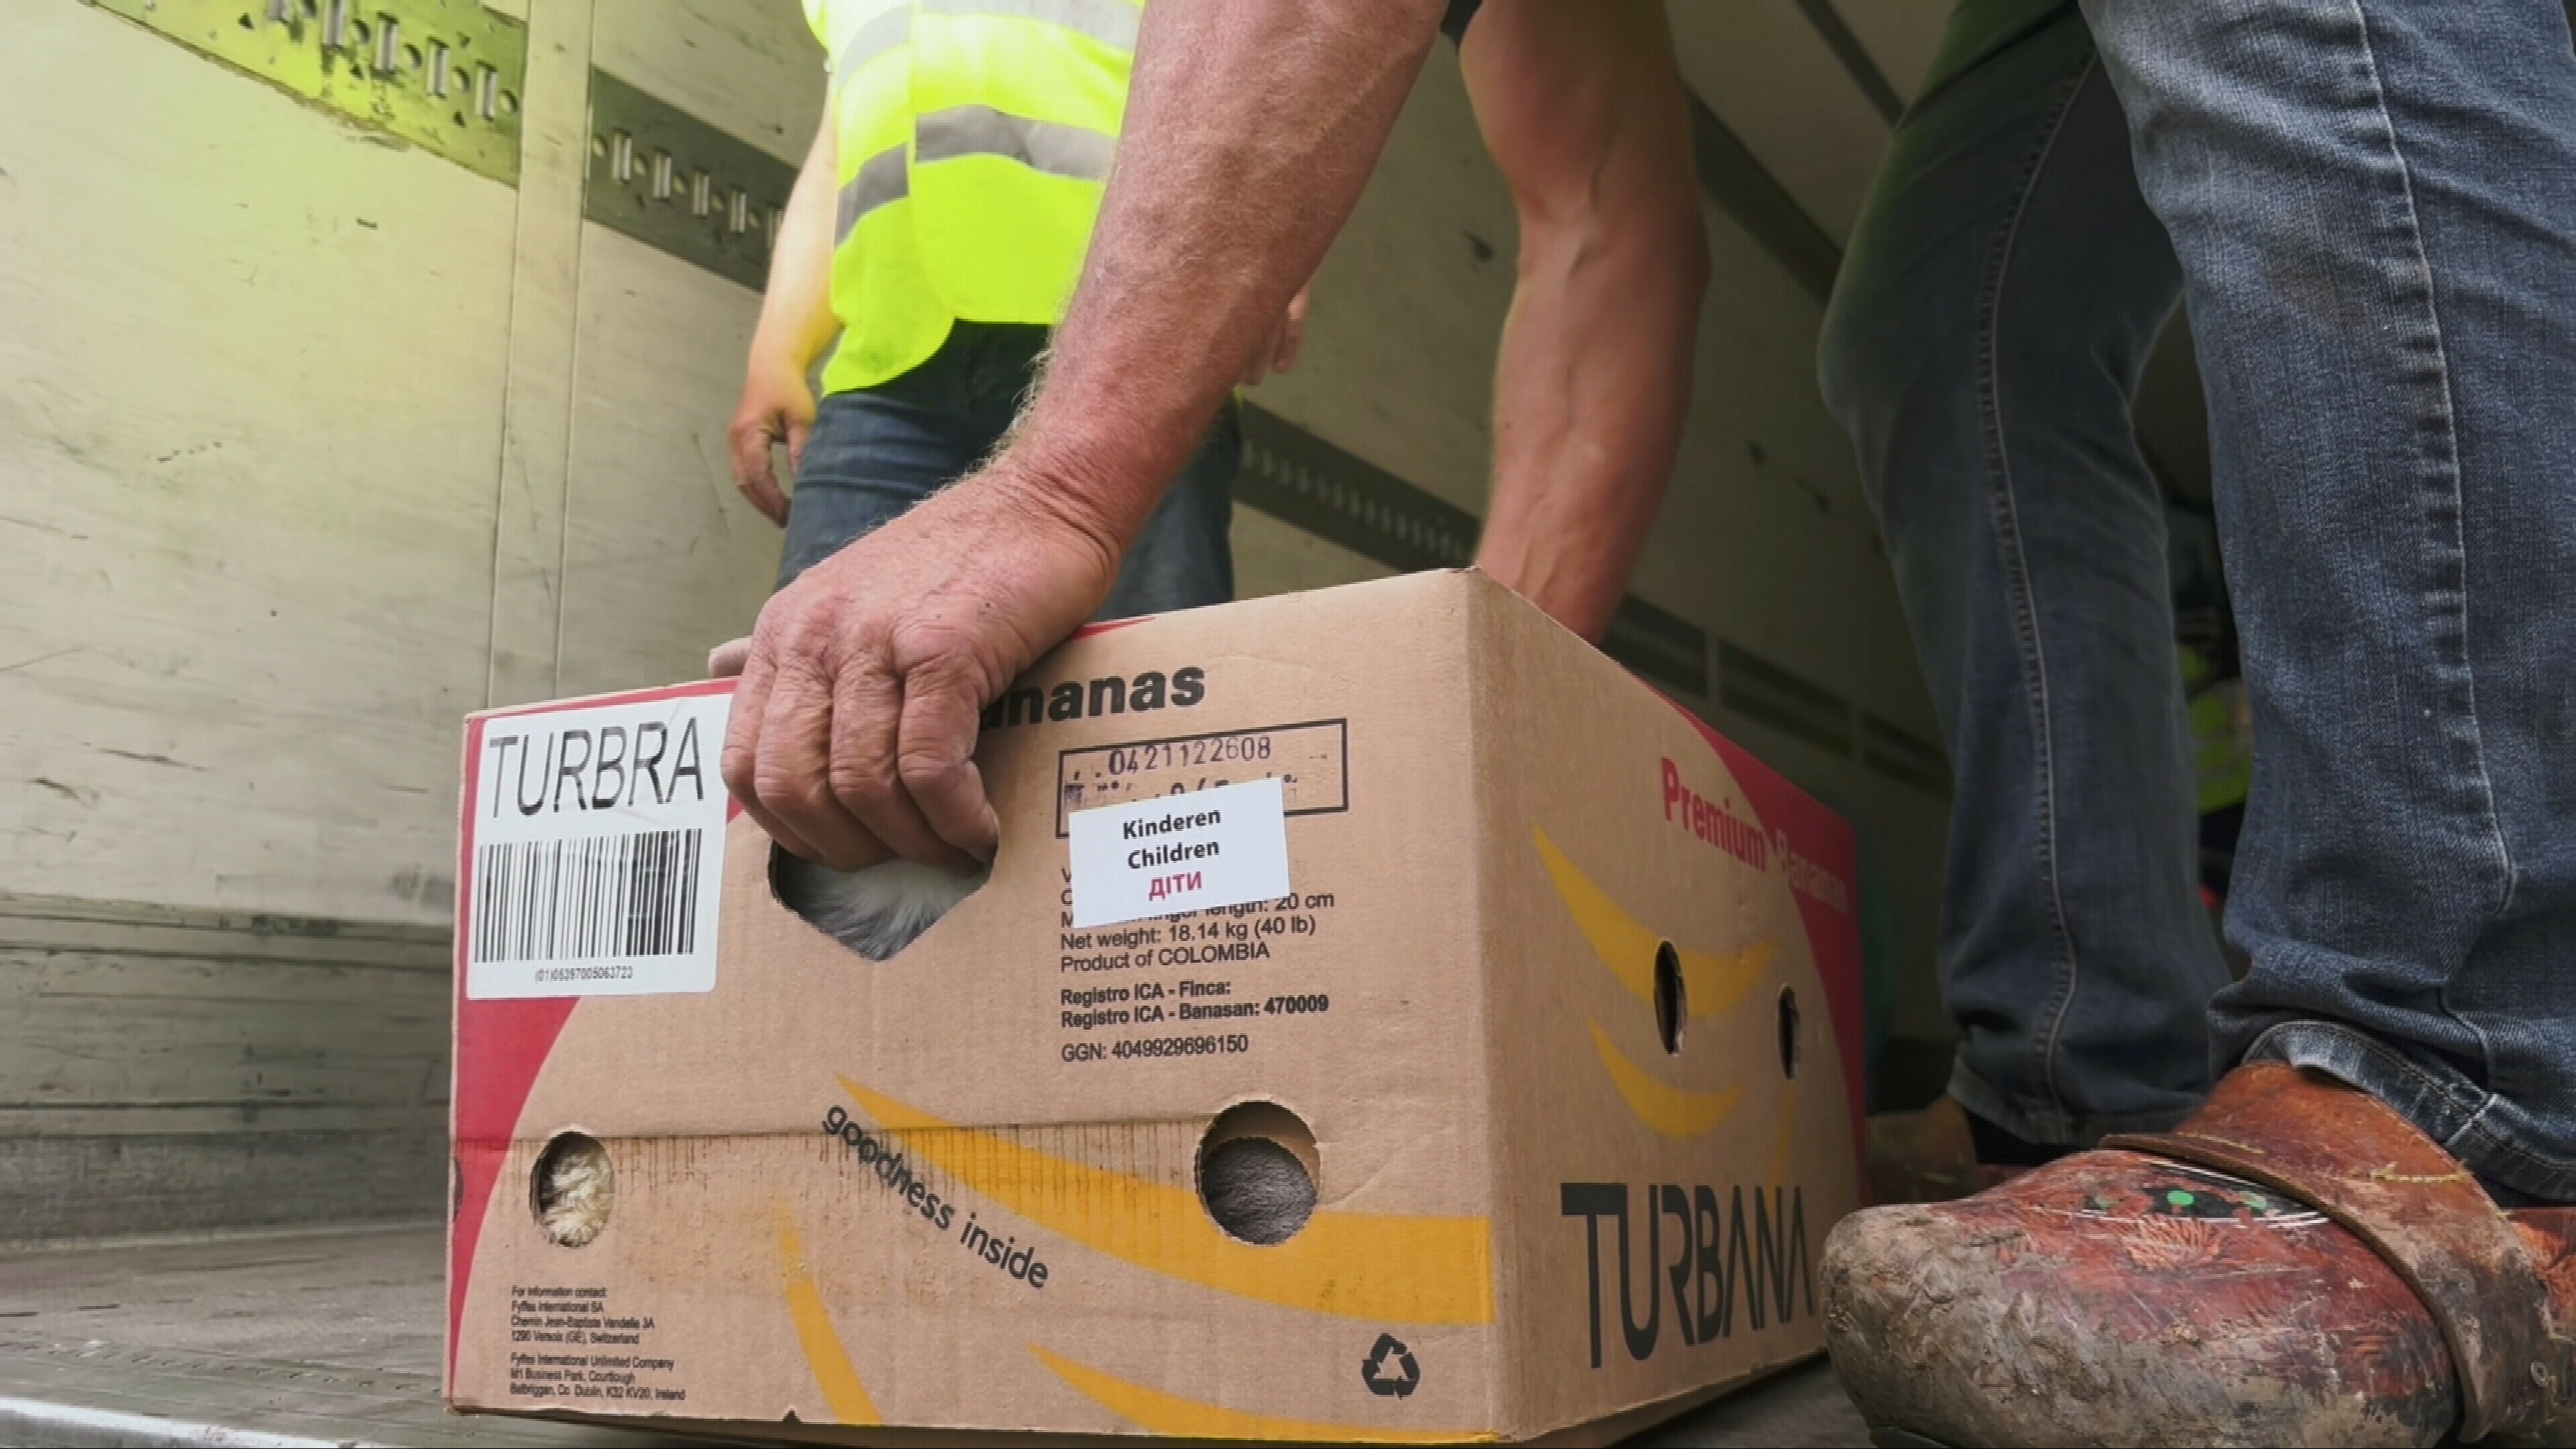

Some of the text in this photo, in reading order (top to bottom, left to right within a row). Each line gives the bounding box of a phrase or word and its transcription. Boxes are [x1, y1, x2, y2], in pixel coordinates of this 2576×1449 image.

[488, 716, 704, 818] TURBRA
[1109, 735, 1271, 775] 0421122608
[1123, 810, 1221, 839] Kinderen
[1661, 756, 1766, 871] Premium
[1128, 840, 1220, 869] Children
[1148, 870, 1201, 900] ДІТИ
[1275, 893, 1299, 911] 20
[1305, 893, 1334, 909] cm
[1061, 914, 1316, 950] Net weight: 18.14 kg (40 lb)
[1061, 941, 1270, 972] Product of COLOMBIA
[1061, 985, 1130, 1007] Registro
[1134, 982, 1165, 1000] ICA
[1179, 980, 1231, 998] Finca:
[1061, 1008, 1130, 1030] Registro
[1134, 1005, 1165, 1022] ICA
[1179, 1000, 1260, 1021] Banasan:
[1265, 995, 1329, 1014] 470009
[1061, 1034, 1248, 1063] GGN: 4049929696150
[822, 1106, 1049, 1289] goodness inside
[1560, 1182, 1815, 1370] TURBANA
[633, 1356, 675, 1372] Company
